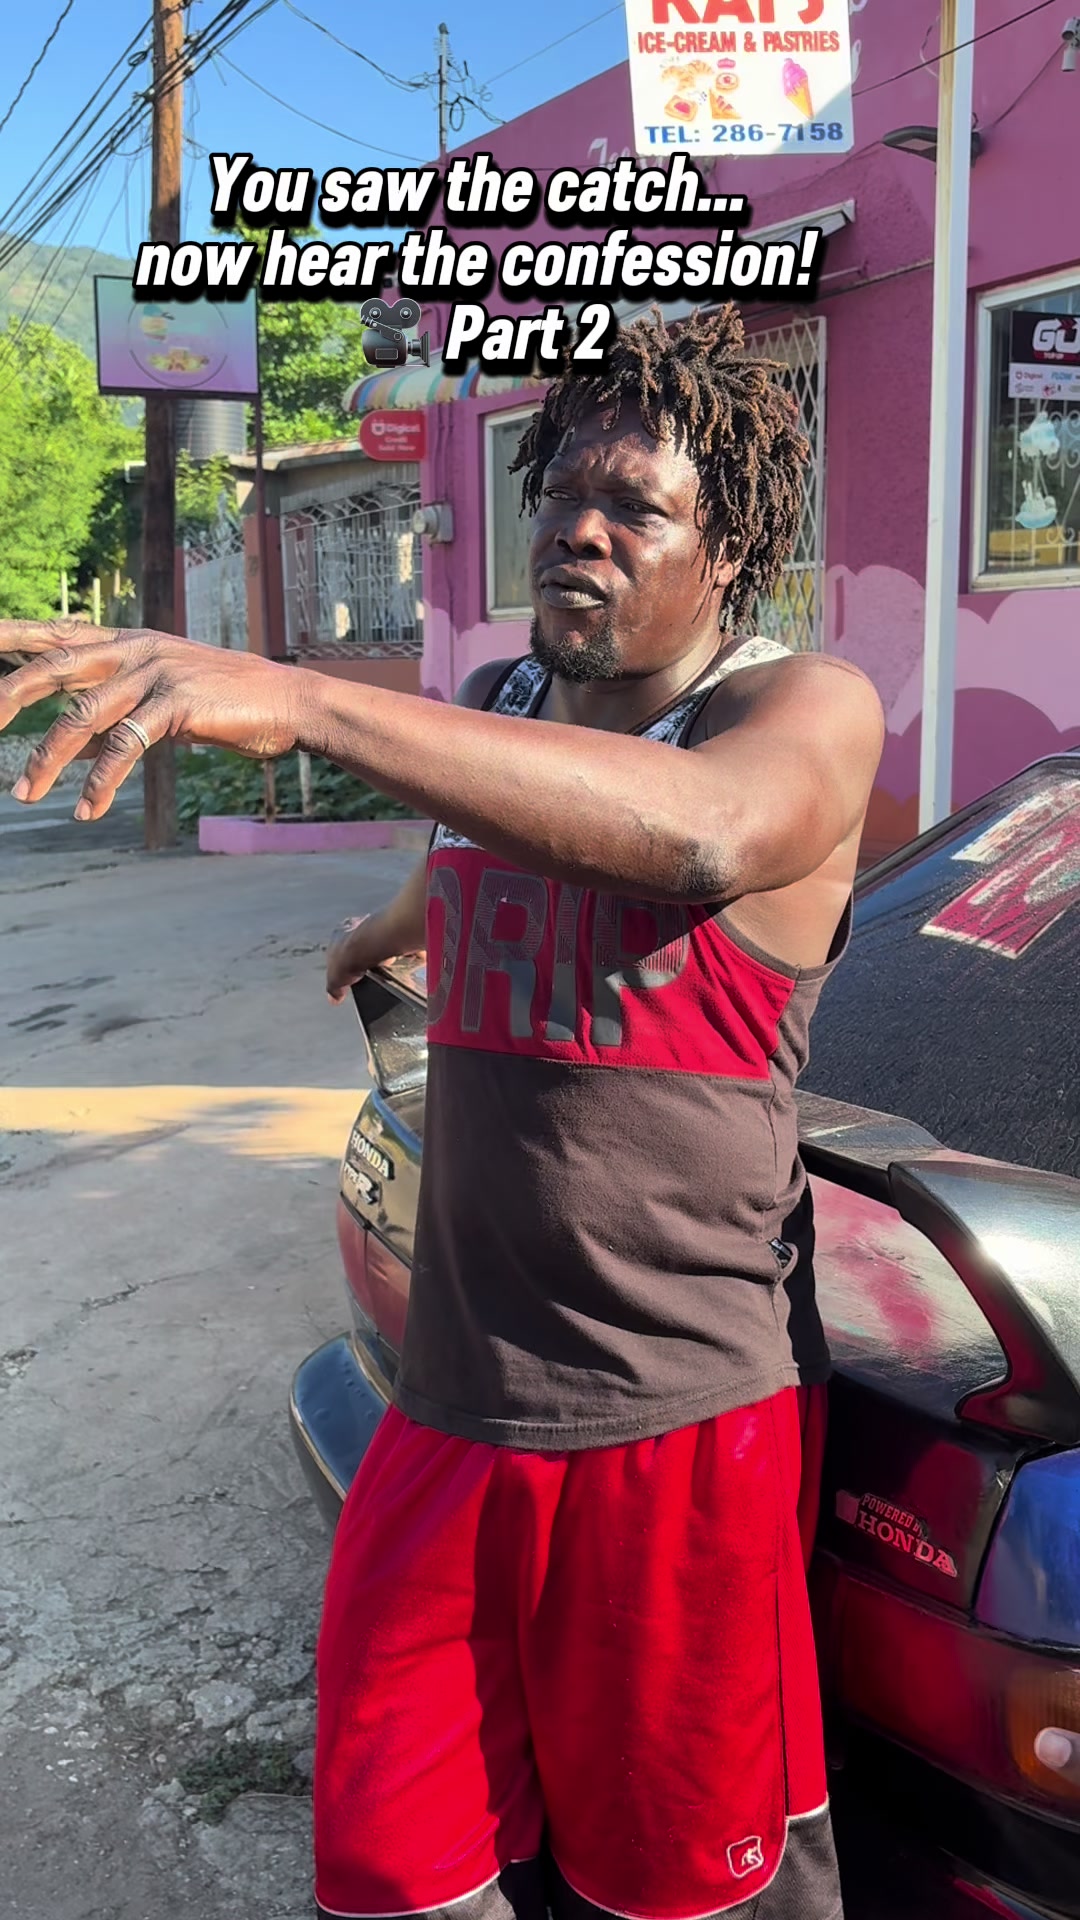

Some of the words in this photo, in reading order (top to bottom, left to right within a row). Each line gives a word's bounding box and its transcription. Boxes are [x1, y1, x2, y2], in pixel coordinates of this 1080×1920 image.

[637, 31, 737, 53] ICE-CREAM
[743, 31, 756, 52] &
[763, 30, 841, 52] PASTRIES
[644, 125, 701, 144] TEL:
[711, 122, 843, 142] 286-7158
[350, 1130, 390, 1180] HONDA
[861, 1495, 914, 1527] POWERED
[858, 1510, 957, 1578] HONDA
